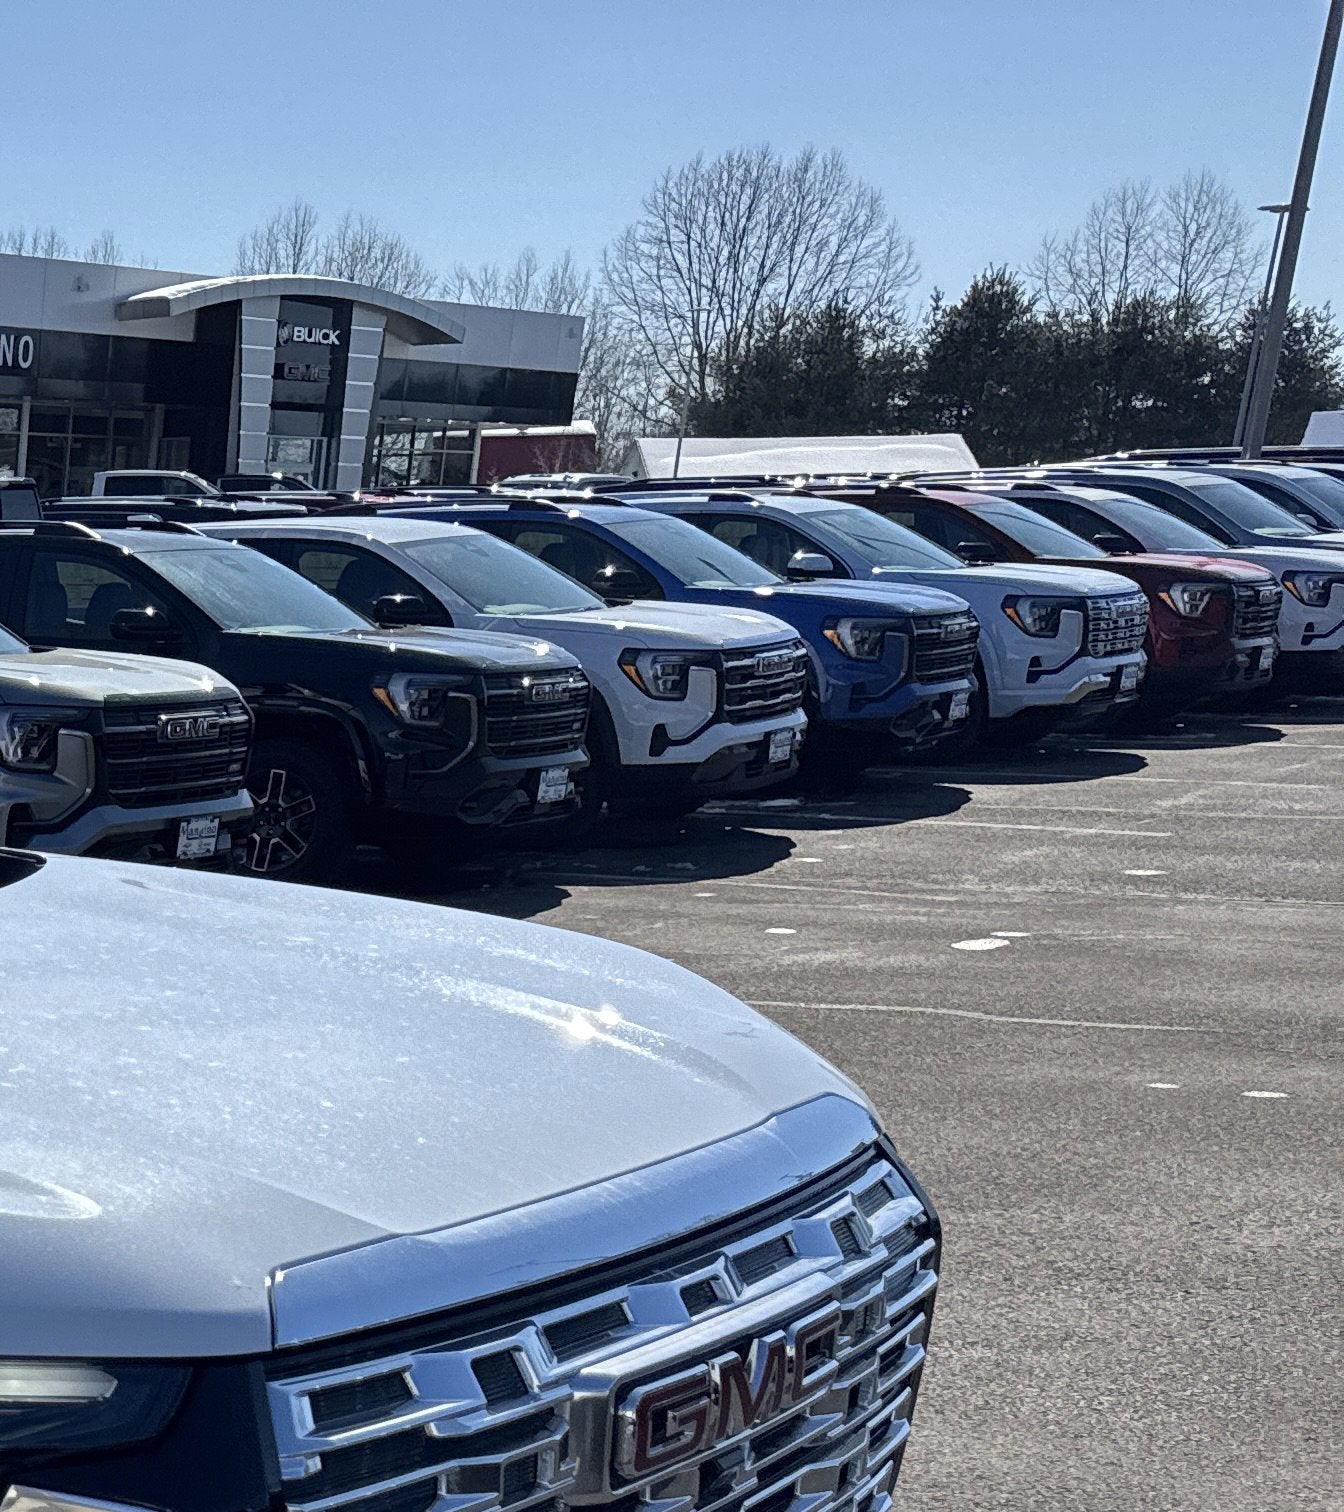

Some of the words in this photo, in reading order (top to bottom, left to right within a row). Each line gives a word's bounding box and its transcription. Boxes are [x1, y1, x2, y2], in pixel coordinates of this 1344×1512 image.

[293, 326, 341, 345] BUICK
[284, 362, 331, 381] GMC
[168, 717, 220, 738] GMC
[617, 1299, 842, 1478] GMC
